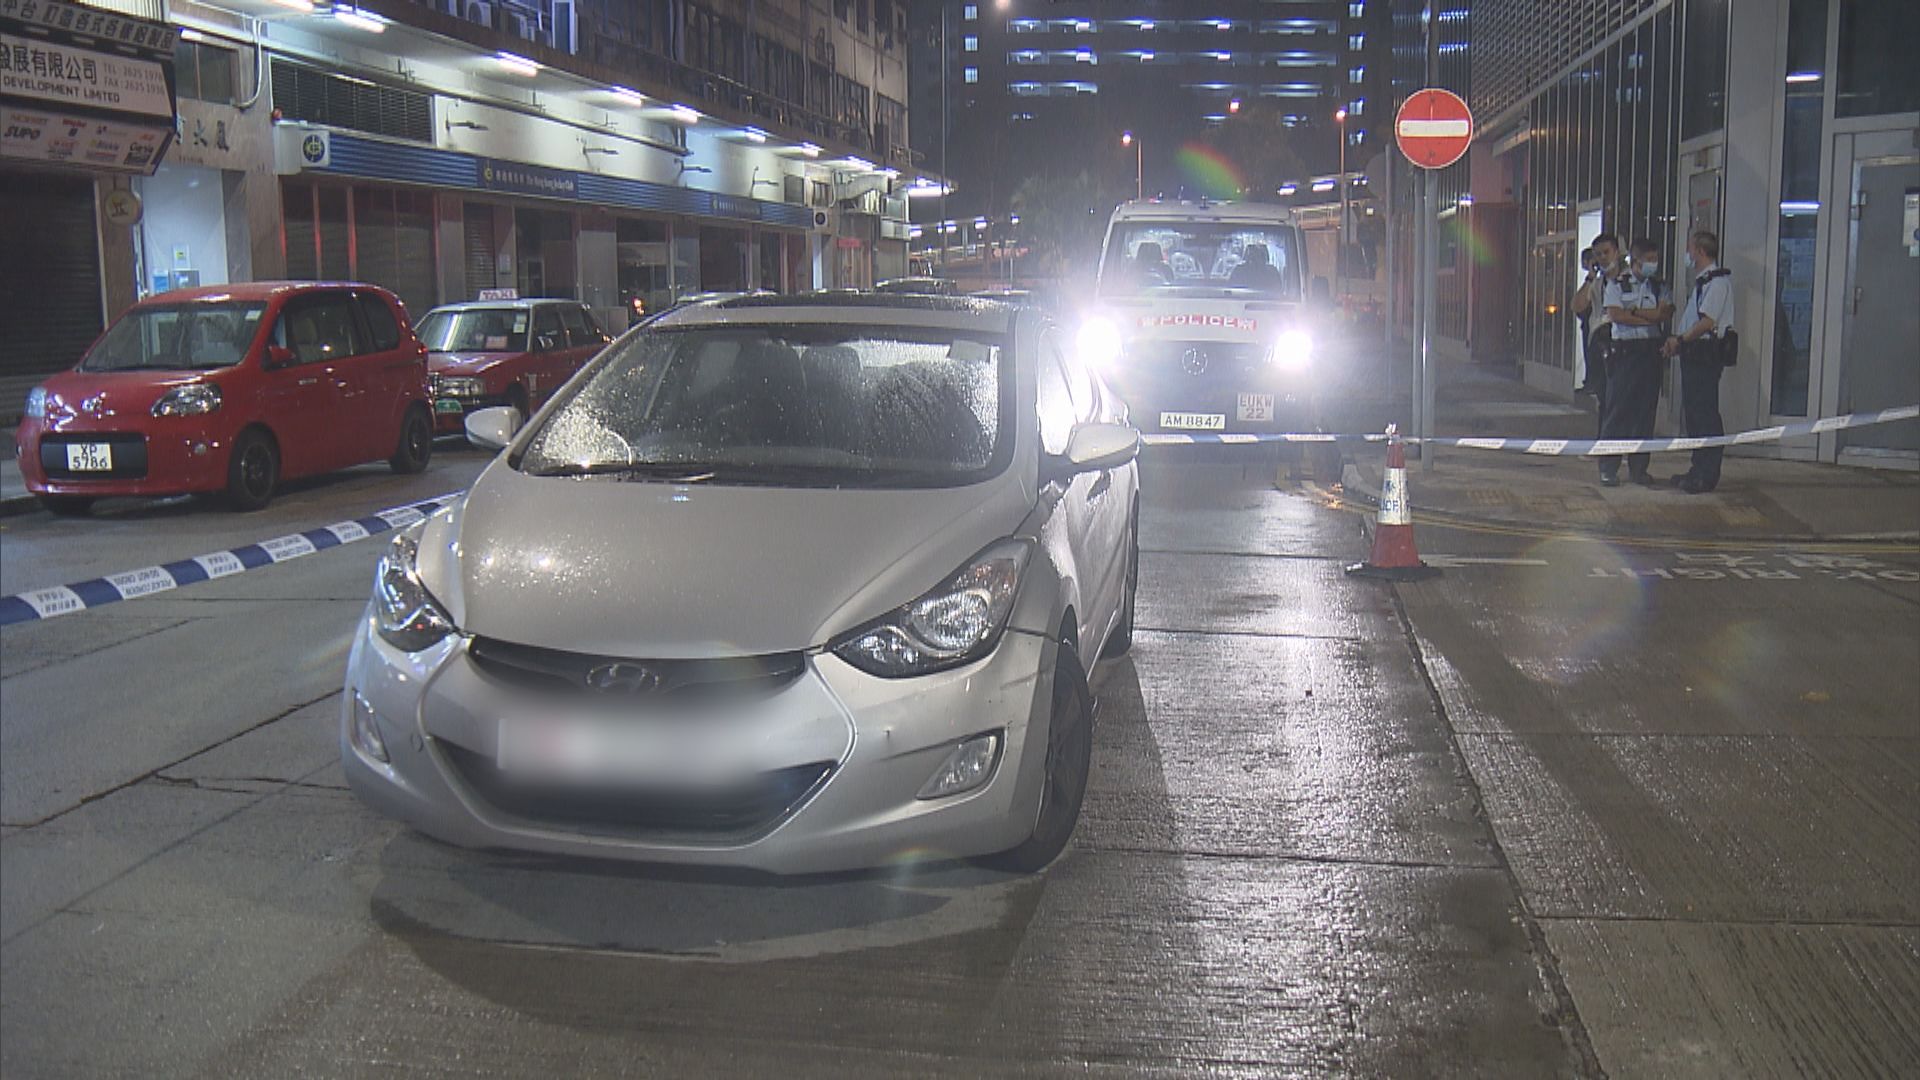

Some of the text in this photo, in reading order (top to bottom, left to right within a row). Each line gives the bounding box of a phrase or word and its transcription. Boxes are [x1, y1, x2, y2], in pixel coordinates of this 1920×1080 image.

[4, 75, 120, 104] DEVELOPMENT LIMITED
[482, 290, 514, 300] TAXI
[1160, 315, 1236, 328] POLICE
[1239, 395, 1273, 408] EUKW
[1245, 408, 1265, 419] 22
[1165, 414, 1221, 427] AM 8847
[81, 442, 98, 456] XP
[1587, 567, 1801, 580] RIGHT
